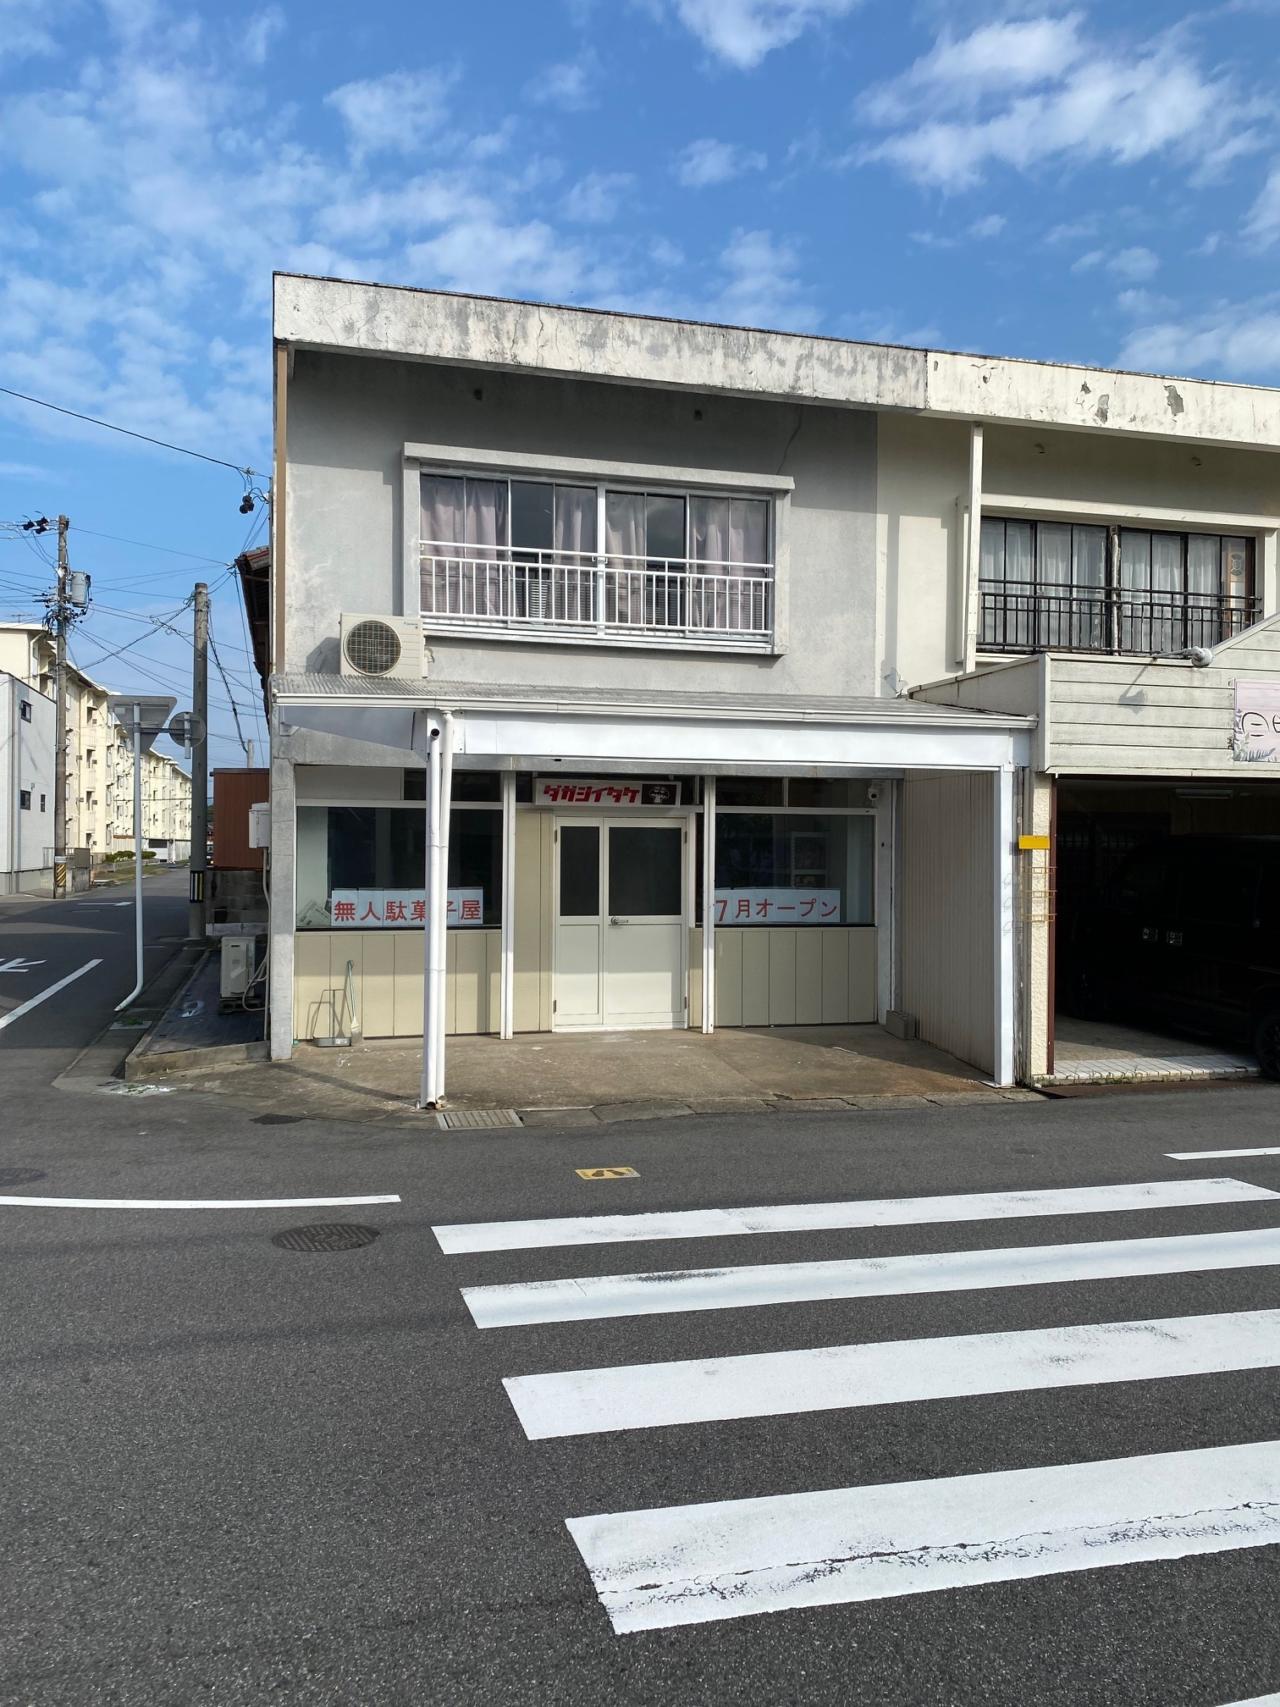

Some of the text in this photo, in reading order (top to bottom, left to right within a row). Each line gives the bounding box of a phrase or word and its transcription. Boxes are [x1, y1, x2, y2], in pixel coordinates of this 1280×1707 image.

[543, 784, 640, 803] ダガシイタケ
[715, 898, 838, 922] 7月オープン
